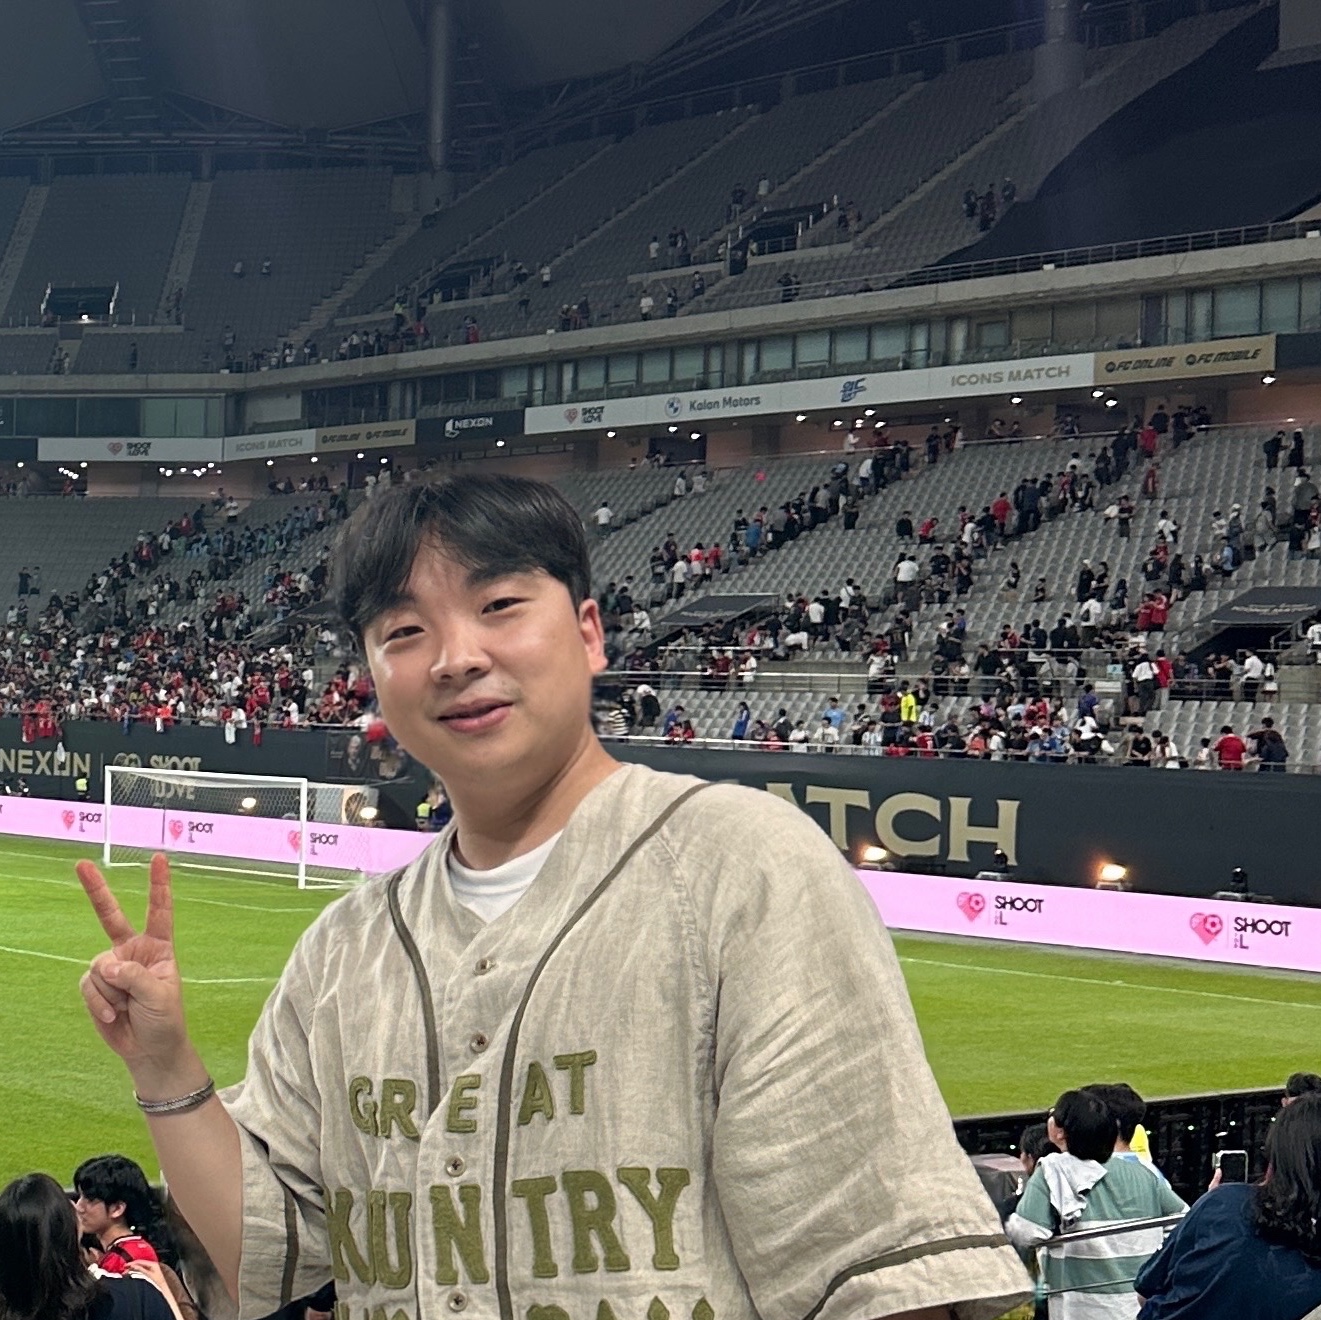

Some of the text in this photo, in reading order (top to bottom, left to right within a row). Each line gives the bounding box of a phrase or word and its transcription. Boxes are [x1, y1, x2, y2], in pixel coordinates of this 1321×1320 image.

[951, 365, 1070, 387] ICONS MATCH
[689, 395, 761, 411] Kolon Motors
[455, 416, 494, 429] NEXON
[236, 437, 303, 453] ICONS MATCH
[0, 748, 91, 777] NEXON
[188, 821, 214, 834] SHOOT
[766, 782, 1021, 867] TCH
[310, 833, 338, 846] SHOOT
[994, 895, 1044, 913] SHOOT
[1233, 916, 1292, 937] SHOOT
[349, 1050, 597, 1140] GREAT
